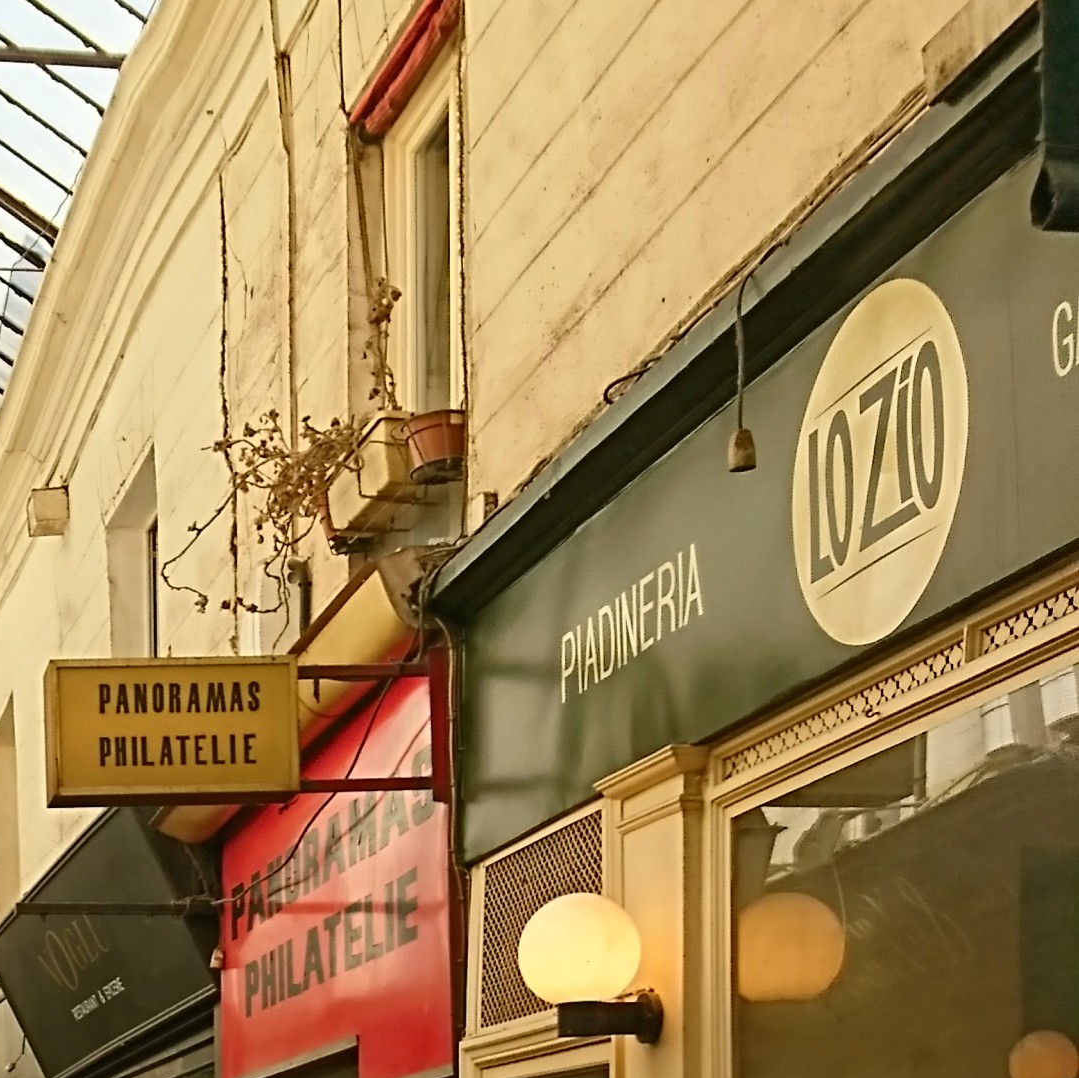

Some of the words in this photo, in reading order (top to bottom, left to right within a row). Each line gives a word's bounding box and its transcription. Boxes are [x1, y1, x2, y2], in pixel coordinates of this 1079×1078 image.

[98, 681, 262, 715] PANORAMAS
[561, 543, 704, 704] PIADINERIA
[98, 734, 257, 767] PHILATELIE
[230, 743, 435, 941] PANORAMAS
[244, 867, 420, 1018] PHILATELIE
